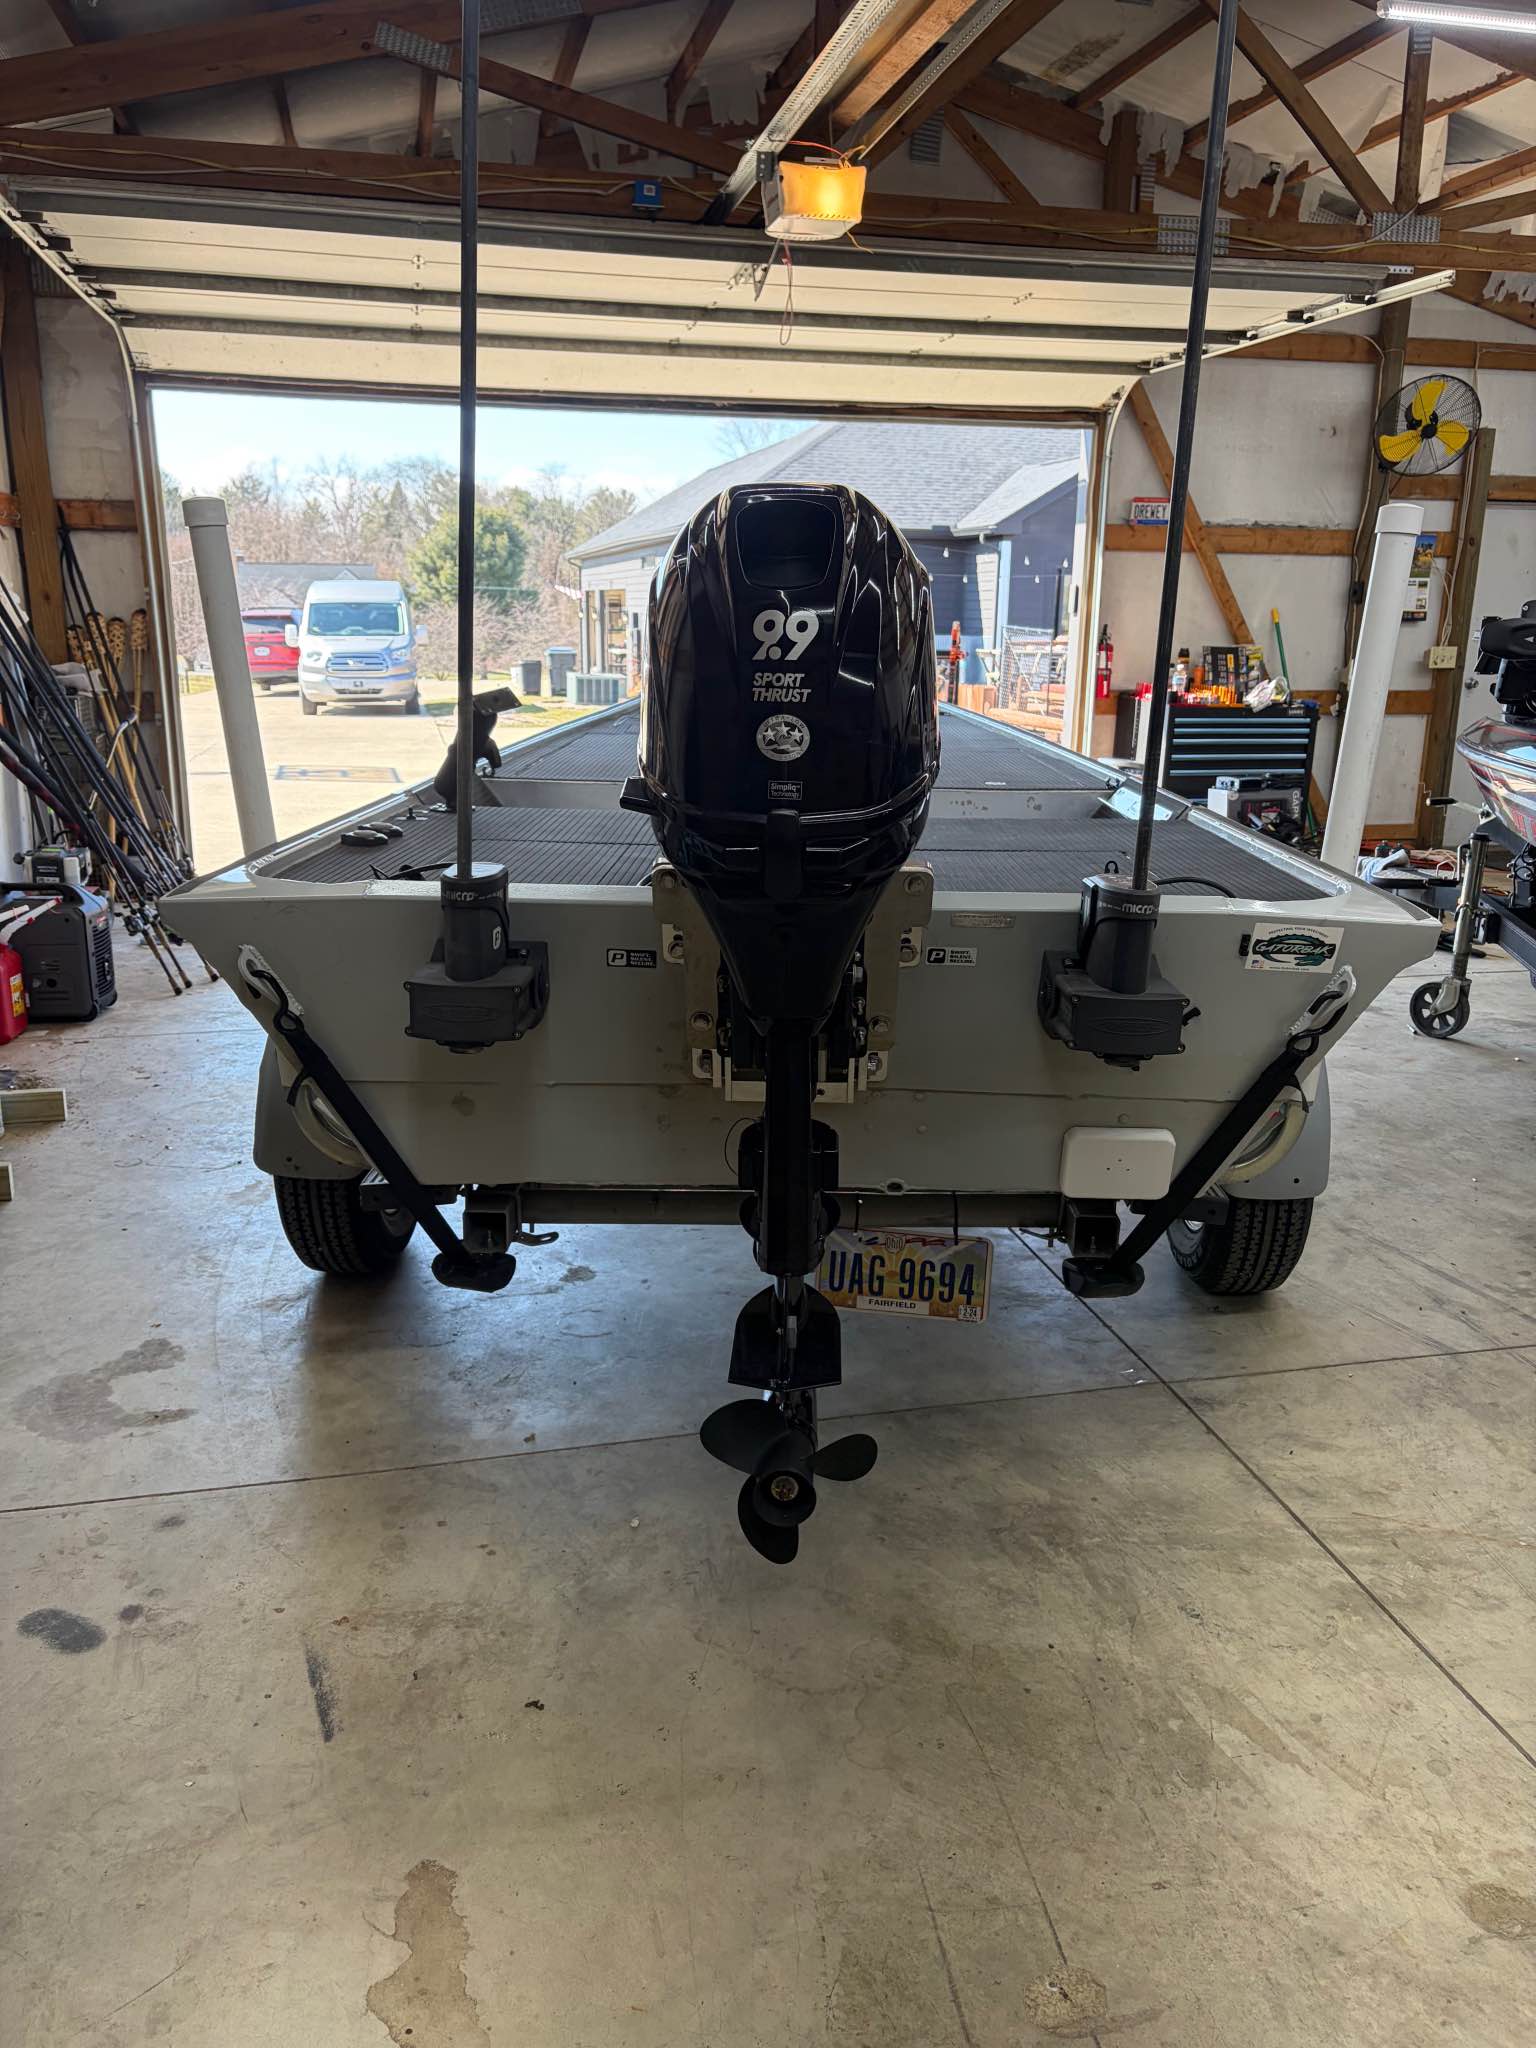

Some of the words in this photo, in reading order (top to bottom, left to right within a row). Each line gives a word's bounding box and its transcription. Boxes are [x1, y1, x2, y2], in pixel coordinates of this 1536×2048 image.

[752, 609, 820, 661] 9.9
[752, 672, 806, 688] SPORT
[752, 687, 812, 703] THRUST
[1255, 941, 1335, 956] GATORBAK
[828, 1250, 886, 1297] UAG
[898, 1257, 975, 1305] 9694
[868, 1298, 917, 1310] FAIRFIELD
